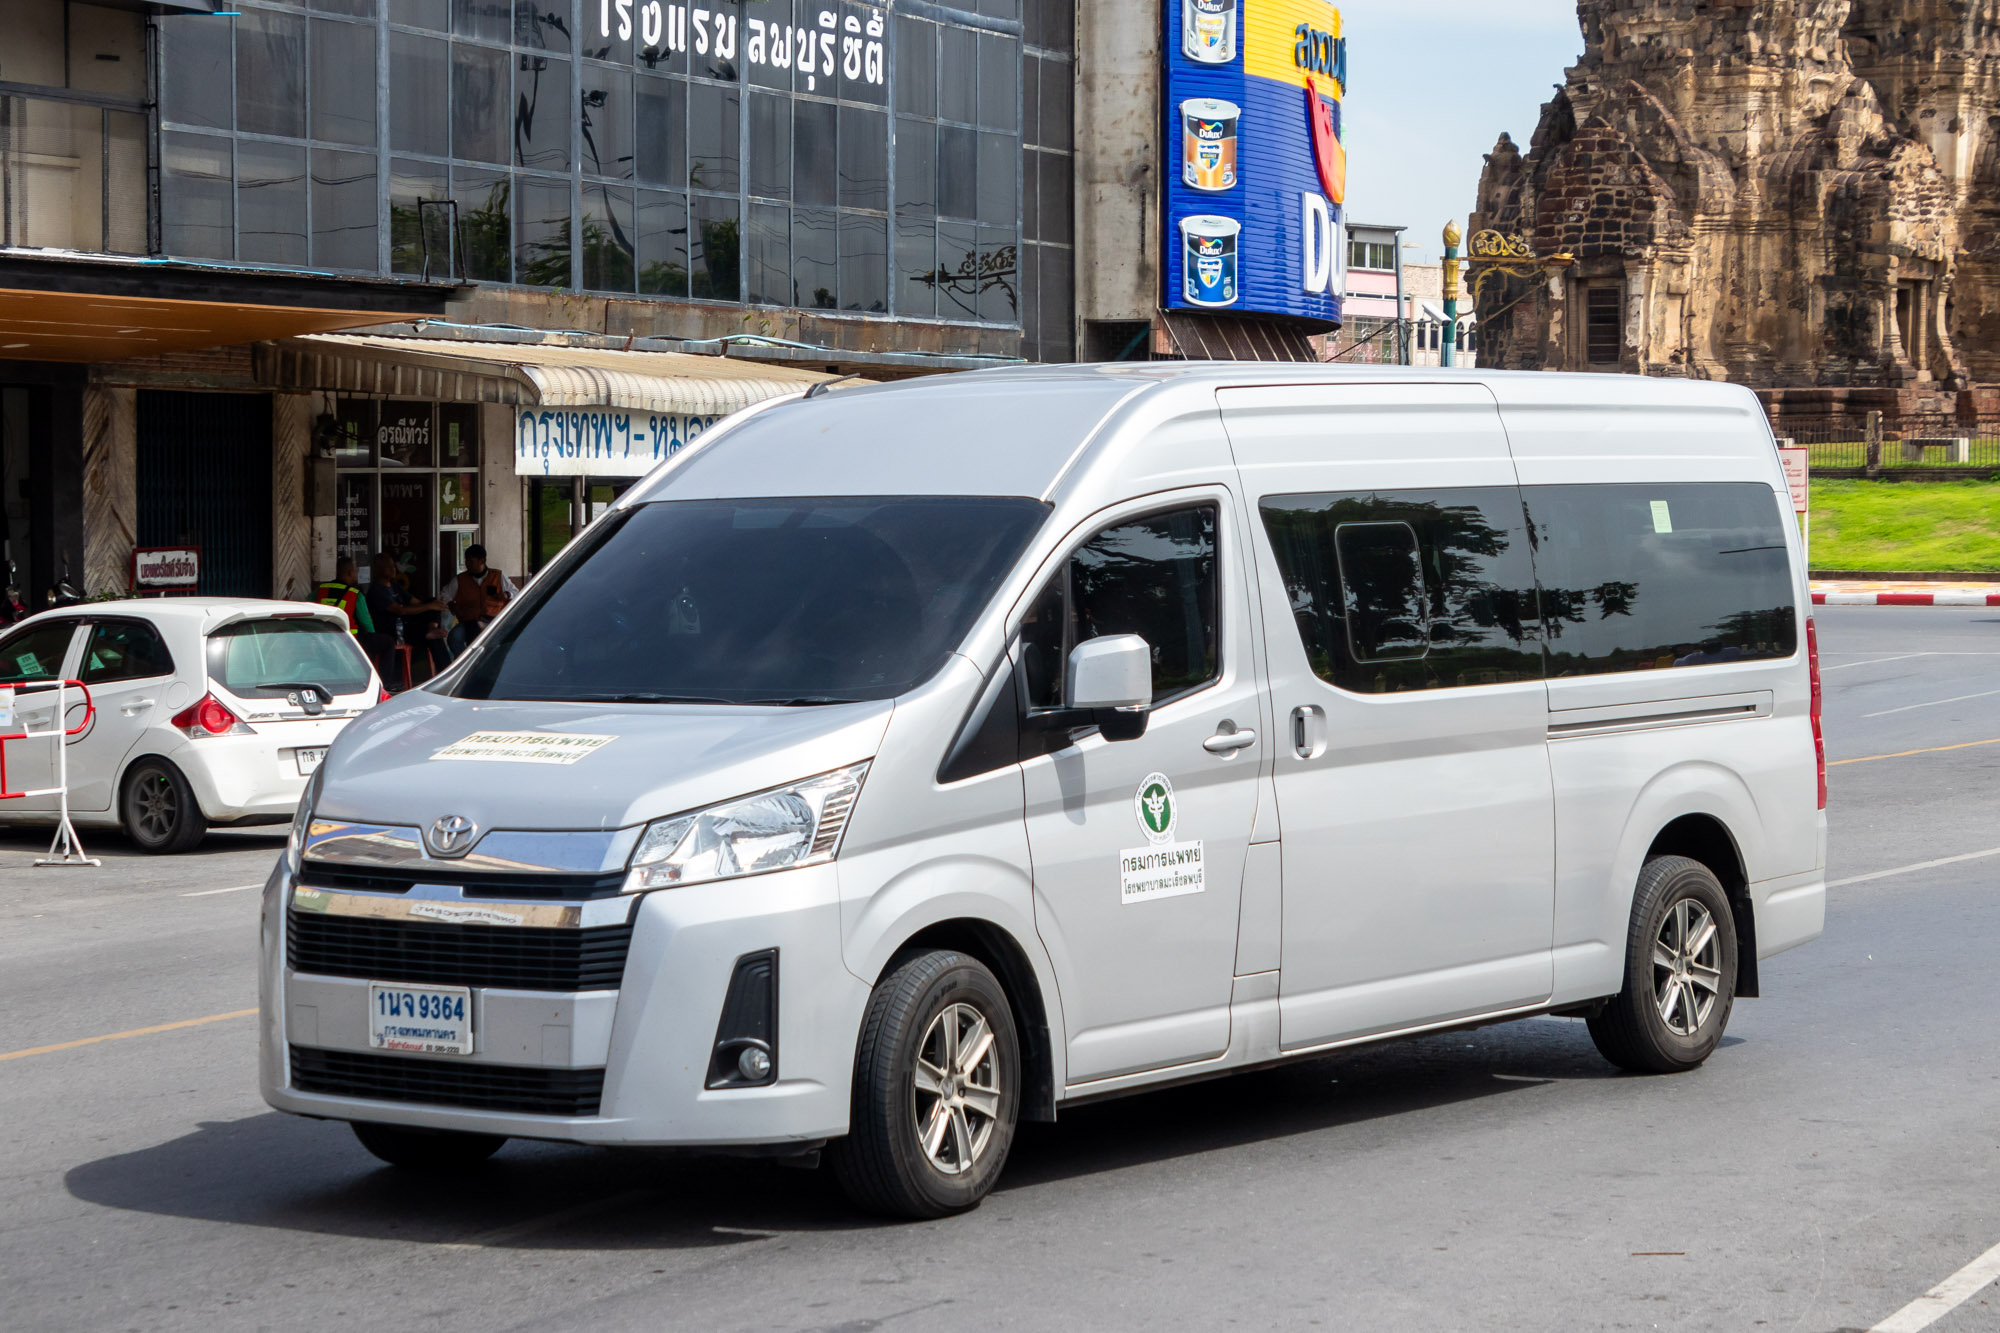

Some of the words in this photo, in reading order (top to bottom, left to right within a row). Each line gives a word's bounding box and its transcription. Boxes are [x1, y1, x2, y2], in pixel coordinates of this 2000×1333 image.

[748, 9, 884, 92] ลพบุรีซิตี้
[1199, 128, 1223, 140] Dulux
[1199, 245, 1222, 256] Dulux
[1302, 191, 1346, 304] Du
[380, 418, 429, 455] อรุณีทัวร์
[461, 735, 616, 748] กรมการแพทย์
[1122, 841, 1201, 873] กรมการแพทย์
[1124, 868, 1203, 895] โรงพยาบาลมะเร็งลพบุรี
[378, 991, 415, 1018] 1นจ
[419, 994, 465, 1021] 9364
[384, 1025, 456, 1041] กรุงเทพมหานคร
